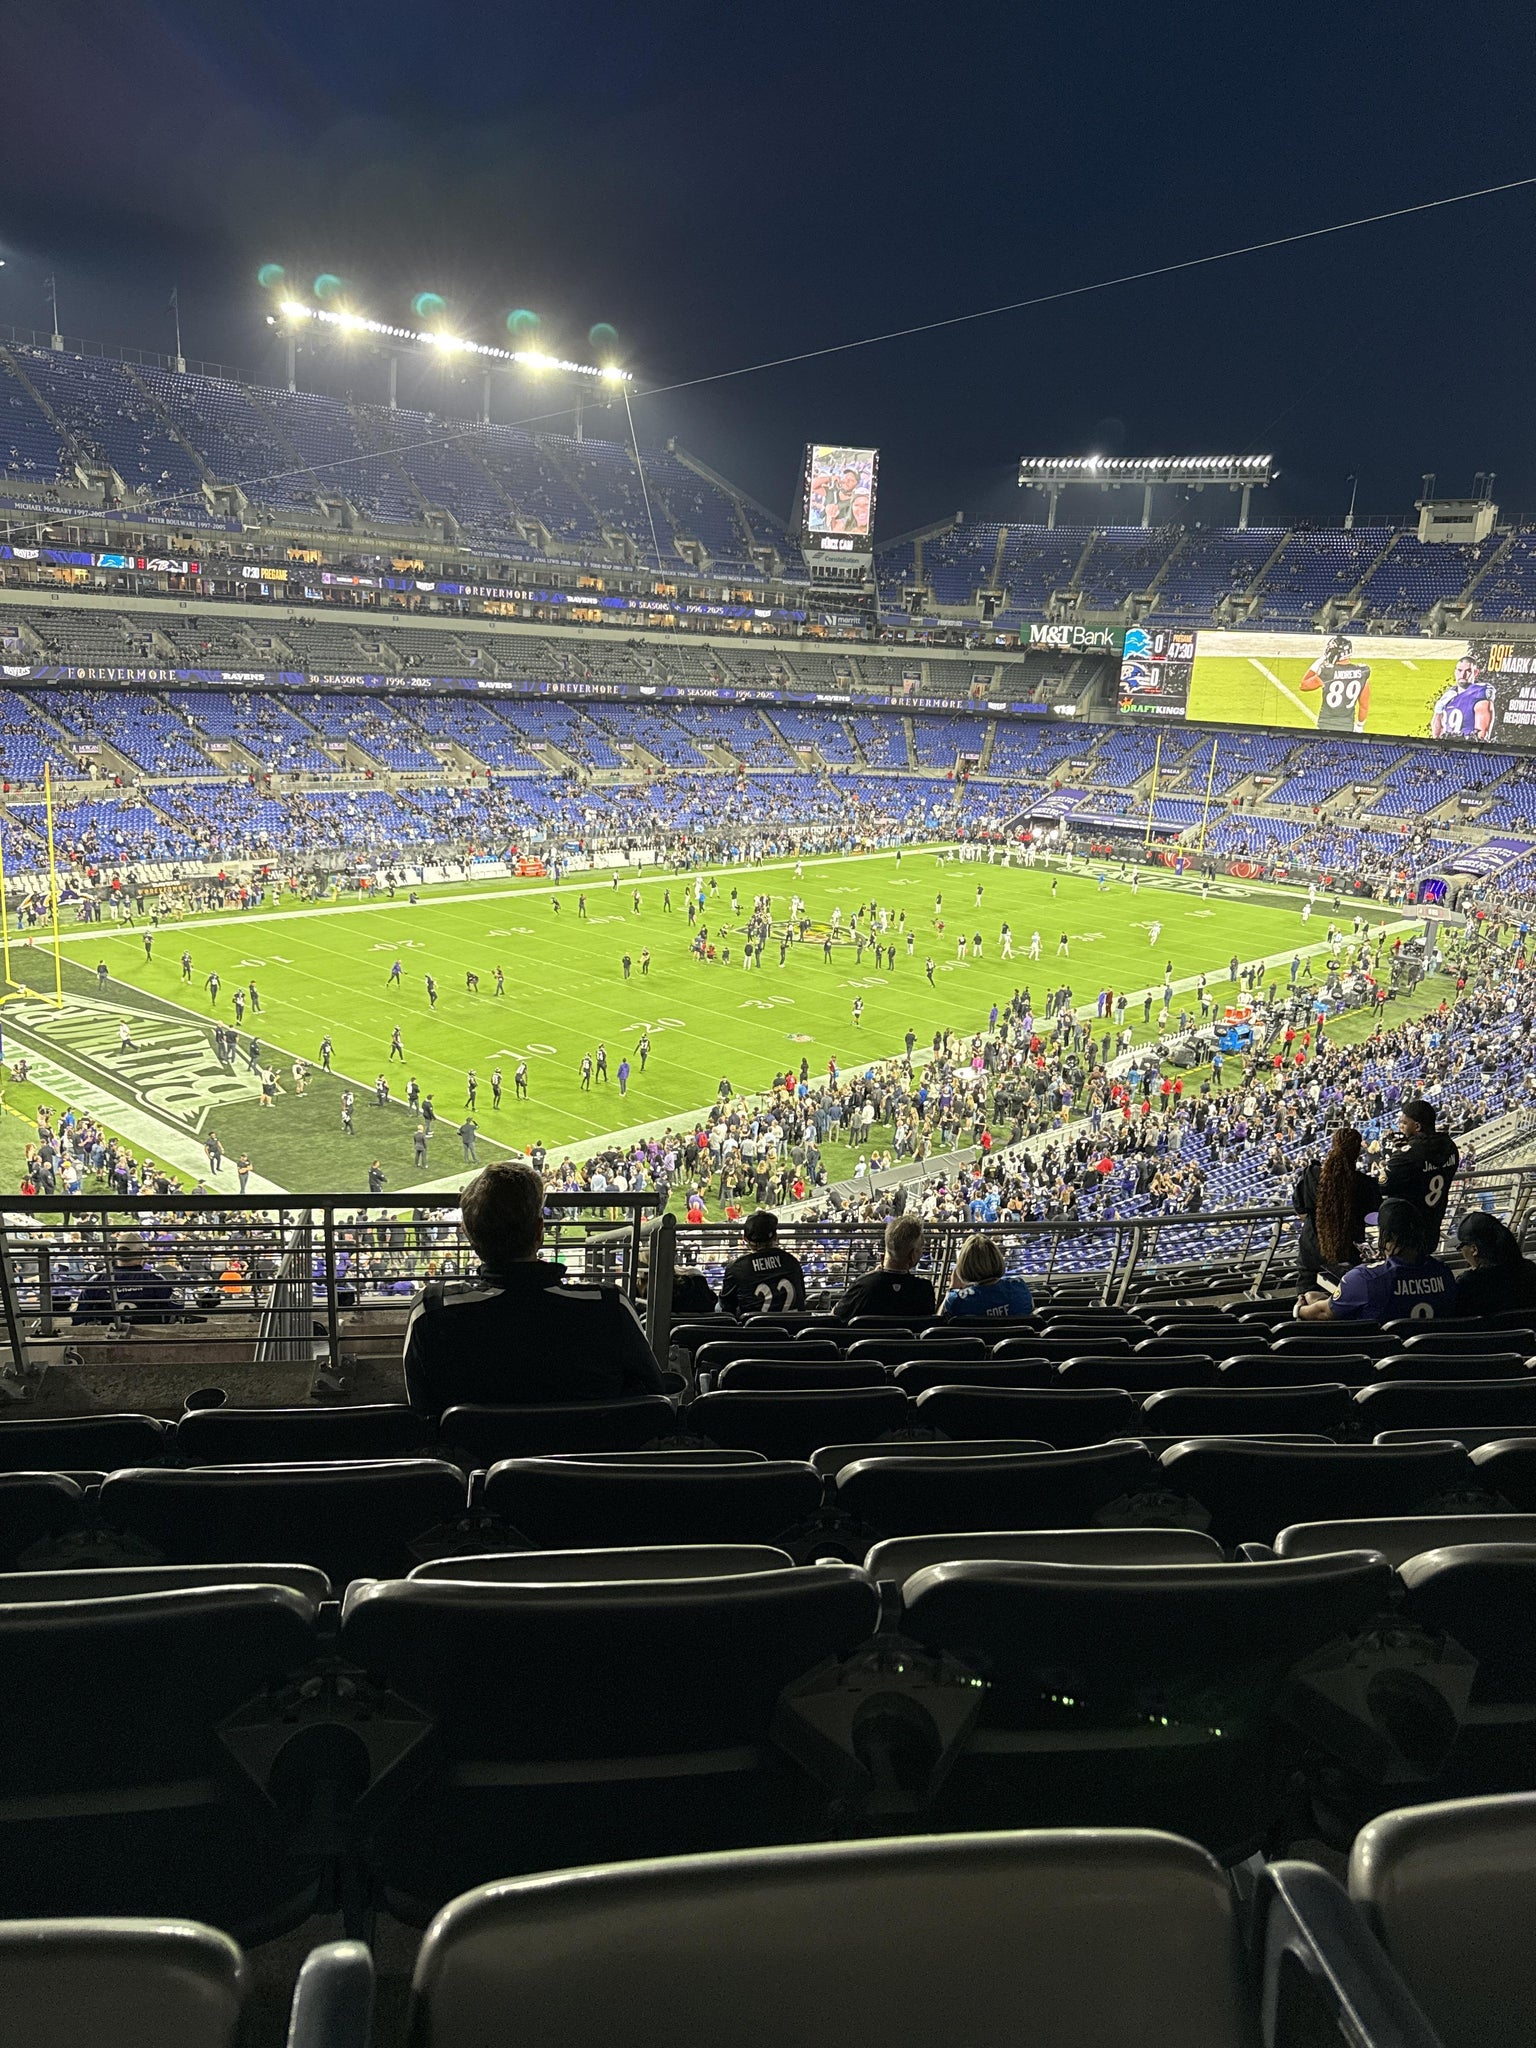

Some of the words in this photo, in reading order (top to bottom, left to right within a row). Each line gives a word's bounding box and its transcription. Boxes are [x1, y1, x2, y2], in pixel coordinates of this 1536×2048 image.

[14, 503, 42, 512] MICHAEL
[43, 506, 72, 514] McCRARY
[147, 516, 165, 524] PETER
[166, 518, 196, 527] BOULWARE
[197, 521, 226, 530] 1997-2005
[825, 555, 860, 564] Constellation
[260, 567, 288, 582] PREGAME
[459, 585, 534, 600] FOREVERMORE
[639, 601, 670, 611] SEASONS
[1029, 624, 1073, 644] M&T
[1073, 626, 1115, 646] Bank
[1154, 634, 1164, 653] 0
[1505, 644, 1515, 657] TE
[1168, 643, 1194, 659] 47:30
[1487, 644, 1505, 672] 89
[1501, 657, 1529, 673] MARK
[68, 667, 176, 681] FOREVERMORE
[221, 672, 266, 682] RAVENS
[308, 674, 320, 683] 30
[323, 675, 365, 685] SEASONS
[1150, 668, 1160, 686] 0
[1333, 669, 1362, 680] ANDREWS
[546, 683, 620, 694] FOREVERMORE
[687, 689, 719, 697] SEASONS
[1326, 680, 1362, 709] 89
[884, 696, 963, 709] FOREVERMORE
[1121, 703, 1185, 715] DRAFTKINGS
[1503, 712, 1530, 725] RECORD
[373, 938, 426, 952] 20
[240, 954, 295, 968] 10
[848, 976, 889, 989] 40
[744, 995, 796, 1010] 30
[629, 1017, 687, 1034] 20
[498, 1043, 558, 1062] 10
[1384, 1141, 1394, 1149] 22
[1425, 1174, 1445, 1207] 8
[752, 1255, 782, 1272] HENRY
[1394, 1276, 1445, 1296] JACKSON
[754, 1278, 795, 1312] 22
[986, 1304, 1010, 1317] GOFF
